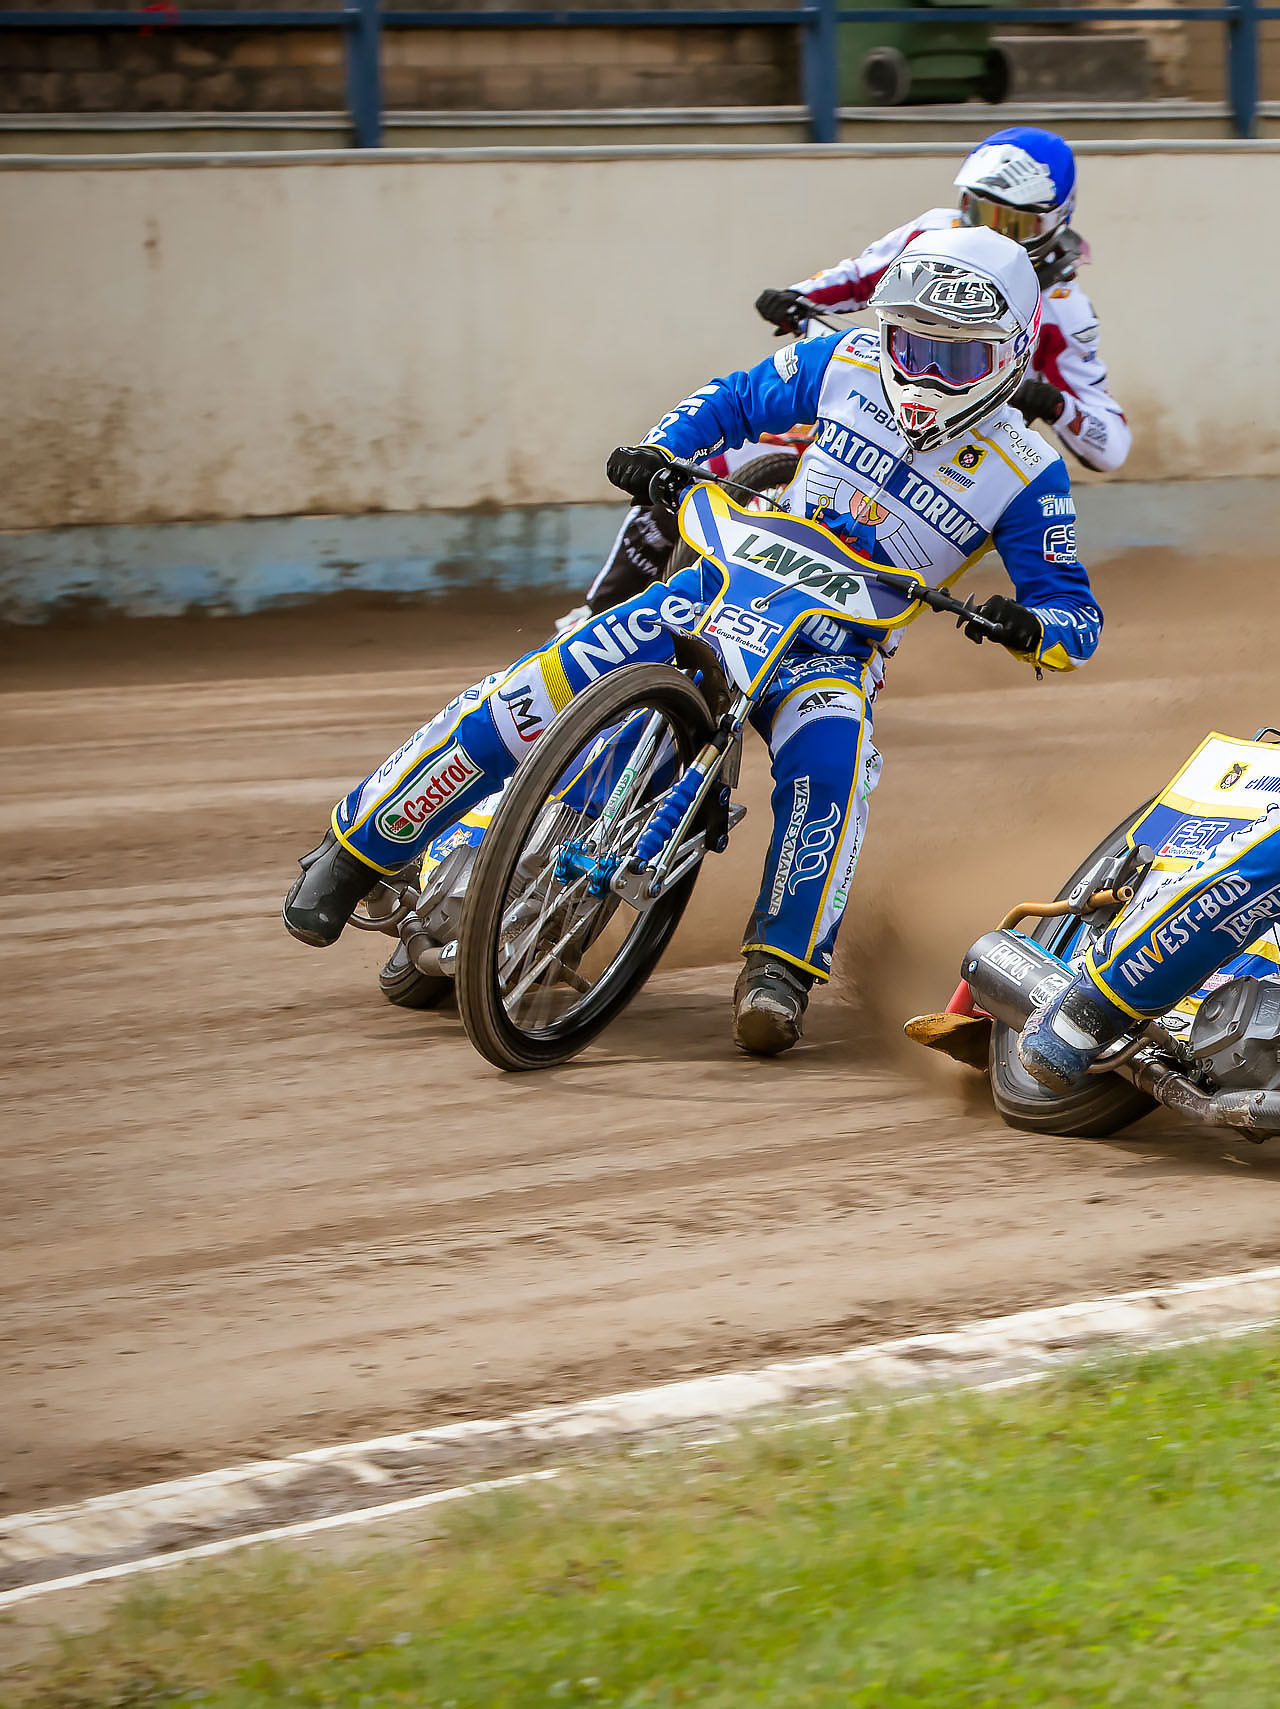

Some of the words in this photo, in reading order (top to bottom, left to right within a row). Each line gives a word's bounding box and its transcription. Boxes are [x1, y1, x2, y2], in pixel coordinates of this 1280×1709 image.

[863, 402, 901, 437] PBD
[567, 595, 697, 681] Nice
[713, 606, 780, 646] FST
[716, 629, 736, 643] Grupa
[736, 636, 768, 655] Brokerska
[403, 753, 475, 824] Castrol
[1171, 820, 1231, 849] FST
[1119, 872, 1252, 987] INVEST-BUD
[986, 940, 1035, 981] TEMPUS
